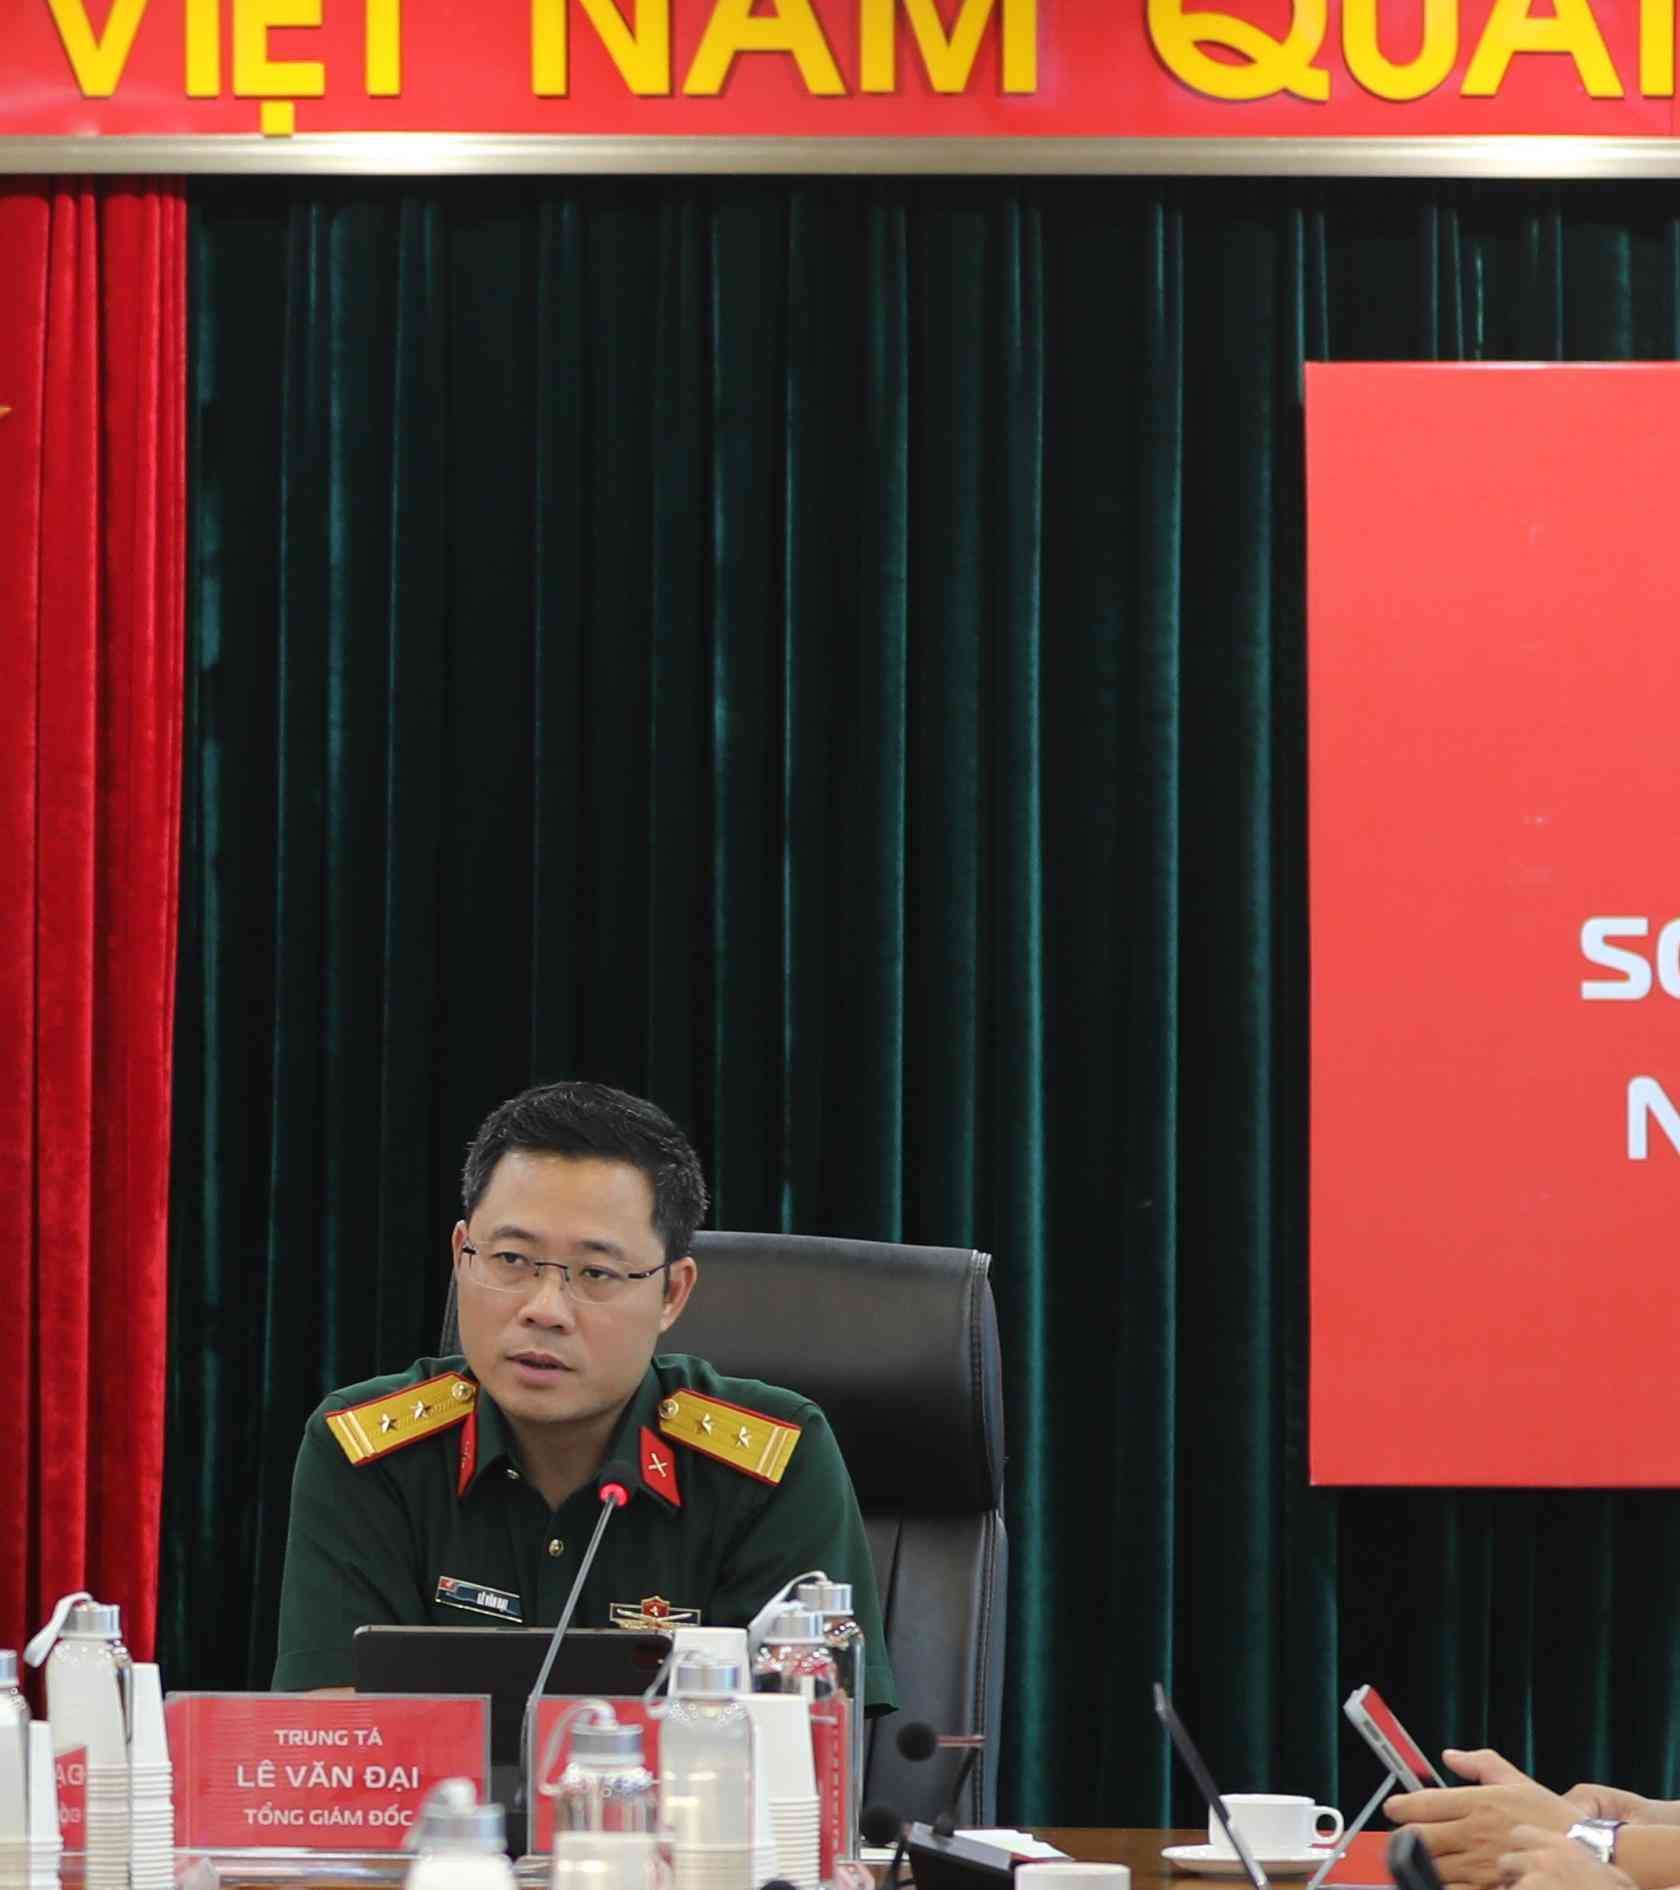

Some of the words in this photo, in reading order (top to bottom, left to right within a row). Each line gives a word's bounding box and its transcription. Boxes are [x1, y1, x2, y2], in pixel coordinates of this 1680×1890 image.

[273, 1729, 349, 1747] TRUNG
[354, 1727, 384, 1747] TÁ
[237, 1759, 277, 1789] LÊ
[286, 1761, 354, 1789] VĂN
[363, 1764, 420, 1793] ĐẠI
[243, 1801, 305, 1827] TỔNG
[308, 1804, 364, 1827] GIÁM
[367, 1803, 414, 1827] ĐỐC
